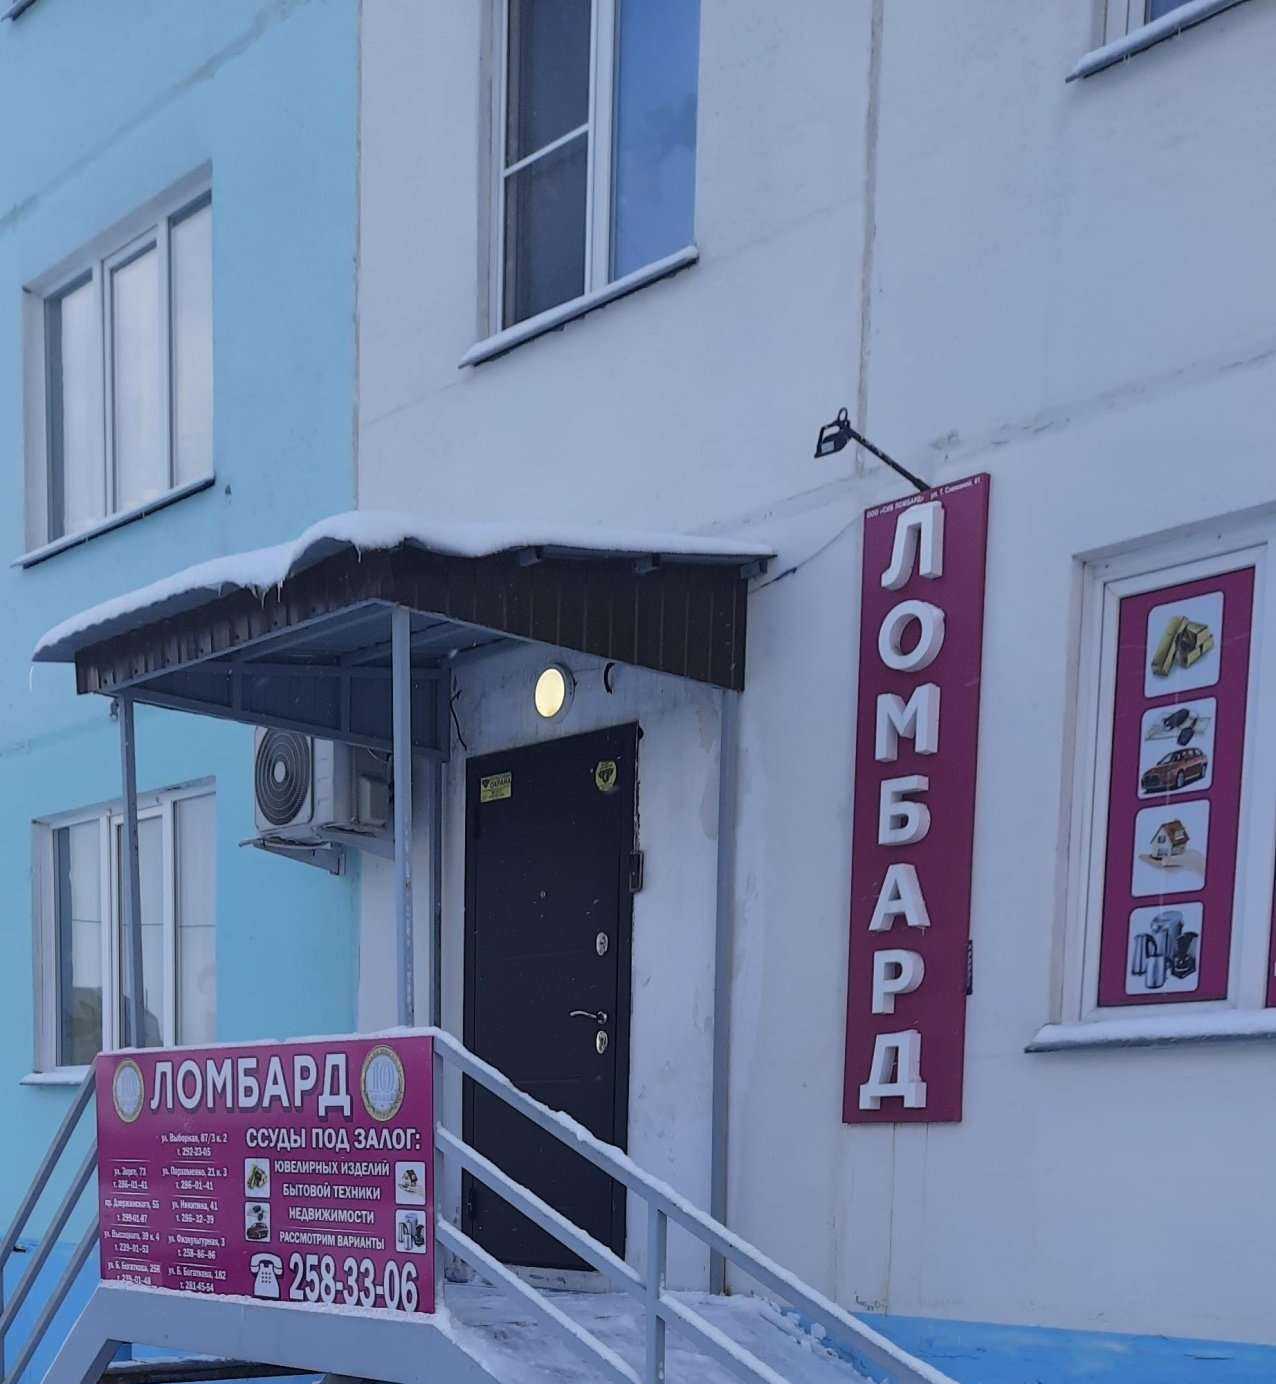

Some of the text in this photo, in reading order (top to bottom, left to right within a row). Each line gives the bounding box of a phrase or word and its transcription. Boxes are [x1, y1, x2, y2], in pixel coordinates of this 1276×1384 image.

[858, 500, 945, 1110] ЛОМБАРД
[150, 1053, 351, 1117] ЛОМБАРД
[246, 1128, 421, 1151] ССУДЫ ПОД ЗАЛОГ:
[274, 1160, 390, 1176] ЮВЕЛИРНЫХ ИЗДЕЛИЙ
[283, 1183, 381, 1200] БЫТОВОЙ ТЕХНИКИ
[288, 1206, 374, 1224] НЕДВИЖИМОСТИ
[279, 1231, 385, 1250] РАССМОТРИМ ВАРИАНТЫ
[289, 1252, 418, 1312] 258-33-06
